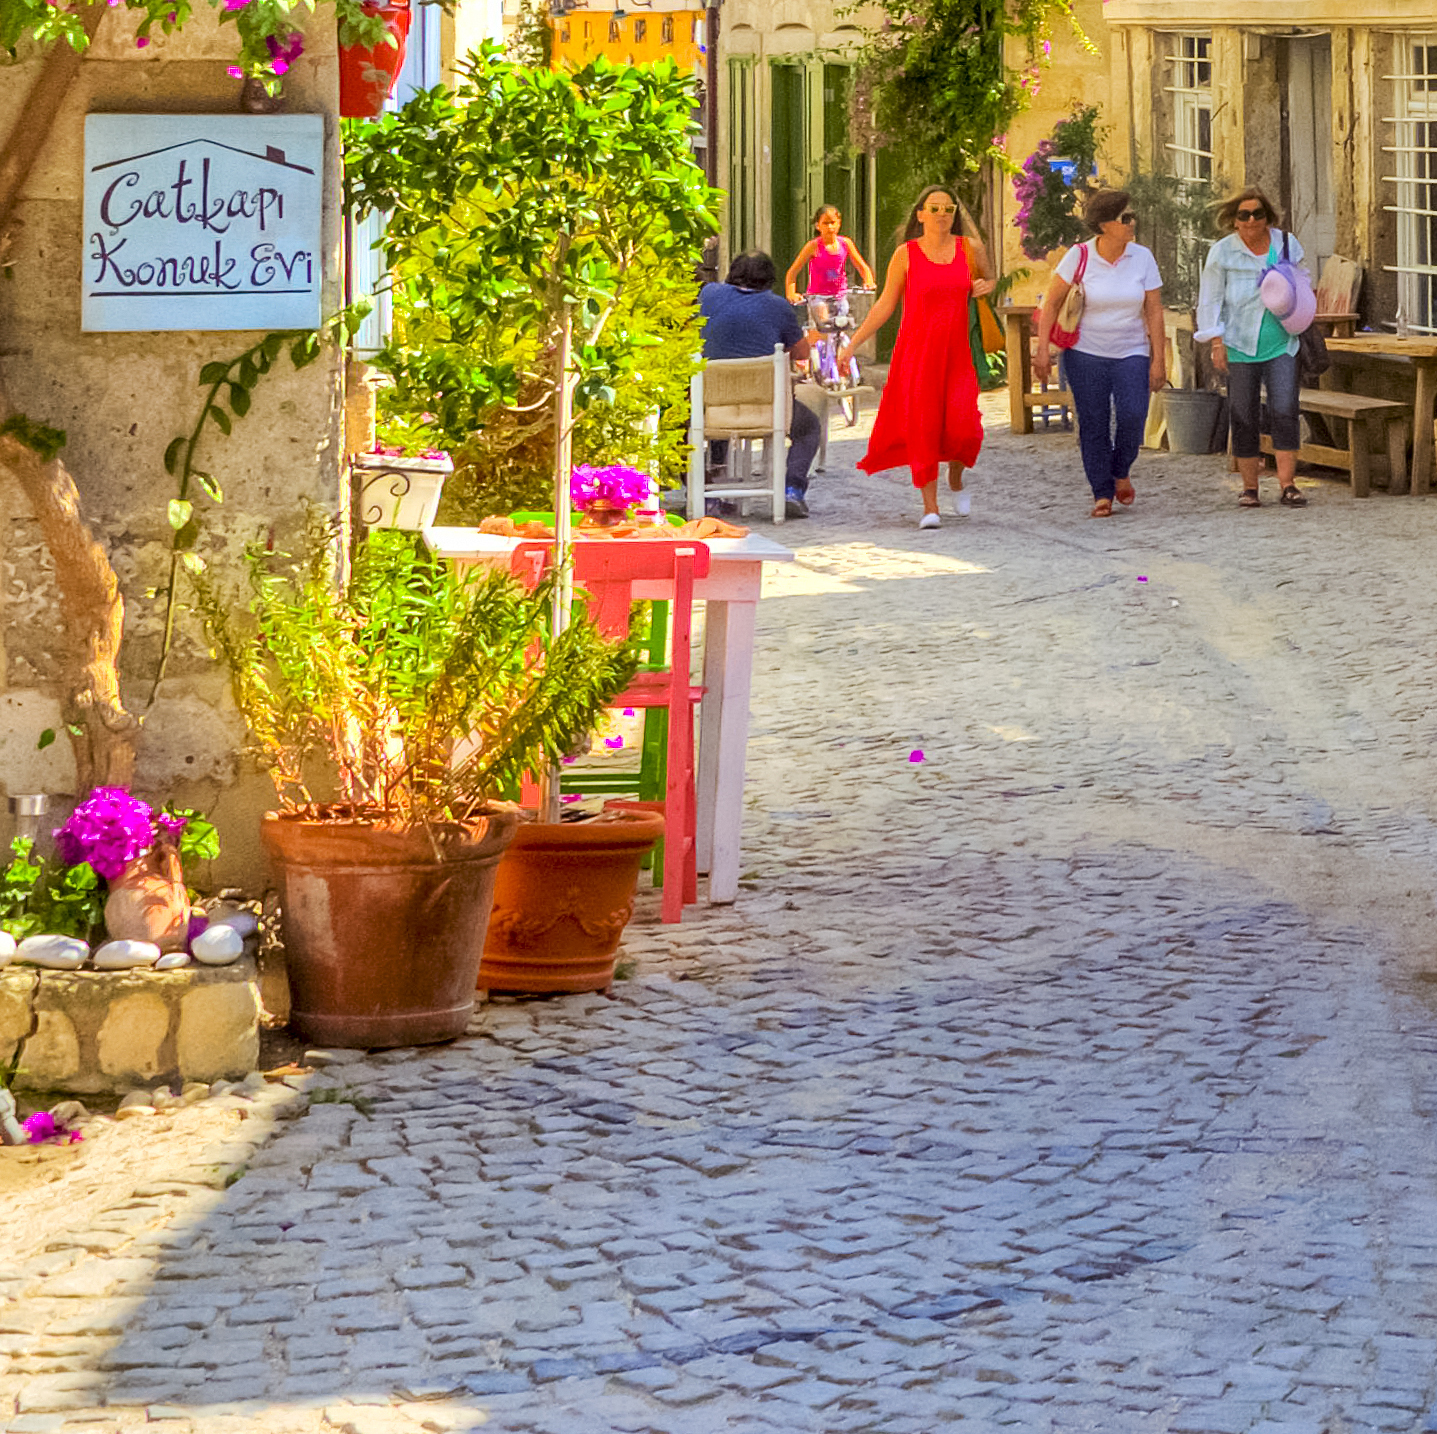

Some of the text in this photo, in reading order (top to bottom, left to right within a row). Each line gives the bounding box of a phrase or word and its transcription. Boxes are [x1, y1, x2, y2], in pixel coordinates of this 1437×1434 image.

[99, 157, 283, 236] Çatkapı
[90, 232, 312, 289] Konuk Evi
